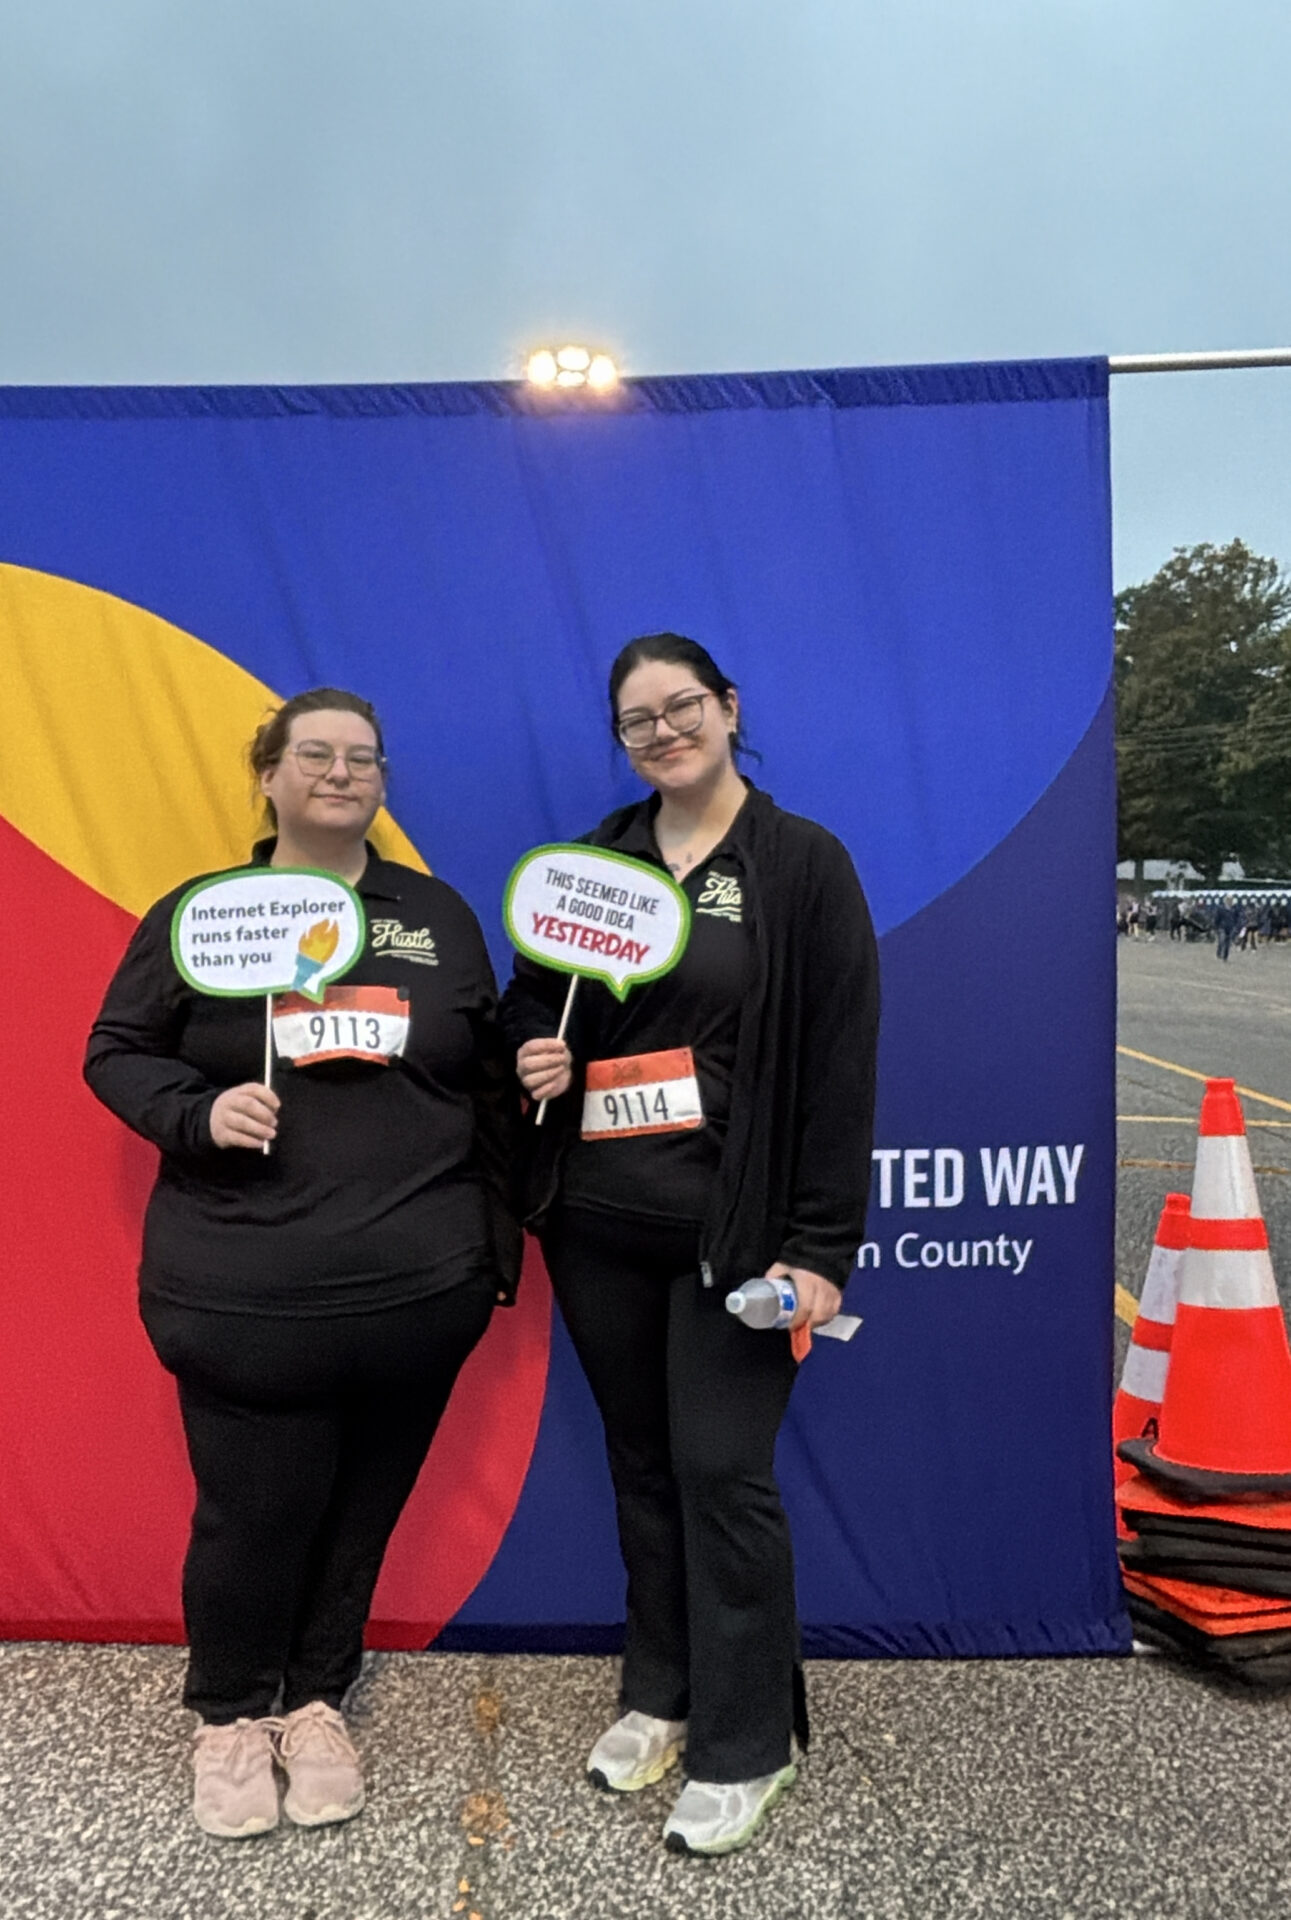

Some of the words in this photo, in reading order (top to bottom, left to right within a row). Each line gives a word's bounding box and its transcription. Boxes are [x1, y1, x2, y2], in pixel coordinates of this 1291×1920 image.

[191, 904, 265, 920] Internet
[270, 899, 345, 918] Explorer
[546, 868, 575, 890] THIS
[575, 878, 628, 906] SEEMED
[629, 893, 660, 915] LIKE
[556, 895, 566, 911] A
[568, 898, 604, 921] GOOD
[604, 909, 635, 931] IDEA
[191, 929, 232, 944] runs
[236, 925, 289, 941] faster
[371, 923, 435, 950] Hustle
[532, 912, 650, 964] YESTERDAY
[191, 951, 234, 968] than
[239, 951, 272, 968] you
[309, 1015, 381, 1050] 9113
[603, 1087, 669, 1127] 9114
[980, 1144, 1084, 1206] WAY
[895, 1232, 1033, 1275] County
